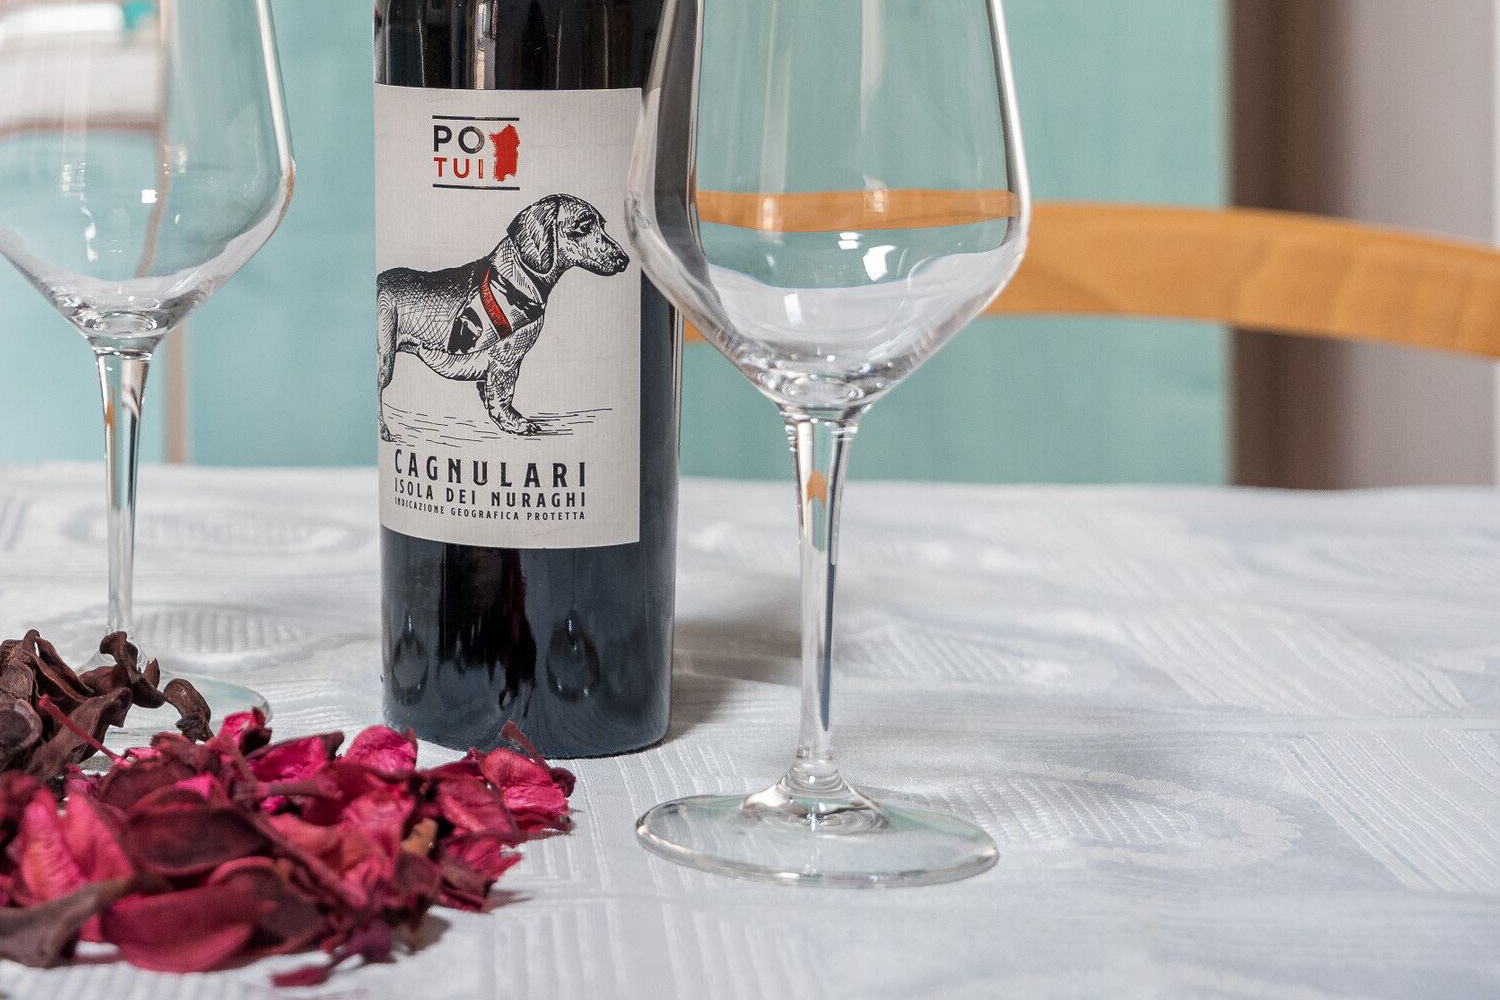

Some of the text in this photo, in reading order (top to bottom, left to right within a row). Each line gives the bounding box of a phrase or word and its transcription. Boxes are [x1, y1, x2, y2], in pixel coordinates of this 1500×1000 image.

[433, 124, 485, 154] PO
[433, 157, 484, 179] TUI
[394, 449, 586, 488] CAGNULARI
[394, 477, 586, 508] ISOLA DEI NURAGHI
[394, 497, 586, 521] INDICAZIONE GEOGRAFICA PROTETTA
